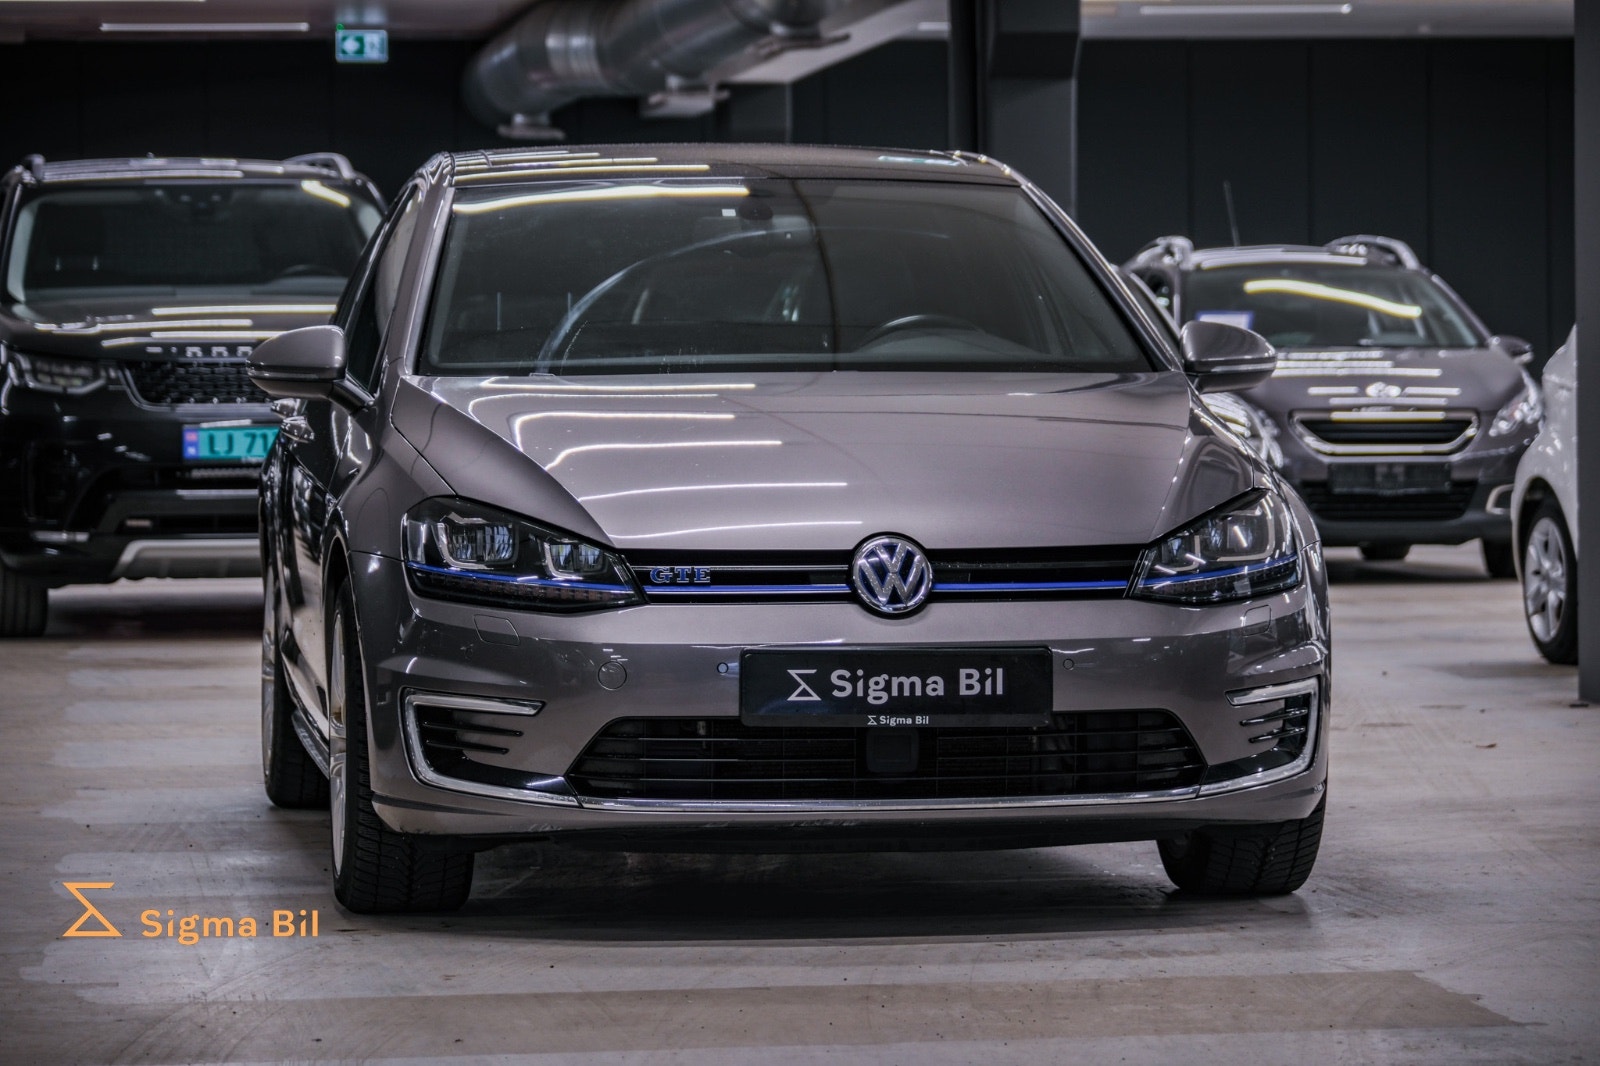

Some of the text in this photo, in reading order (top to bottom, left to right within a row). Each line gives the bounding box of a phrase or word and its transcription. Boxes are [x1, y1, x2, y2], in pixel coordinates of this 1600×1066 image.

[208, 431, 277, 455] LJ 71
[649, 565, 711, 584] GTE
[856, 539, 929, 609] VW
[830, 667, 1004, 705] Sigma Bil
[879, 715, 929, 727] Sigma Bil
